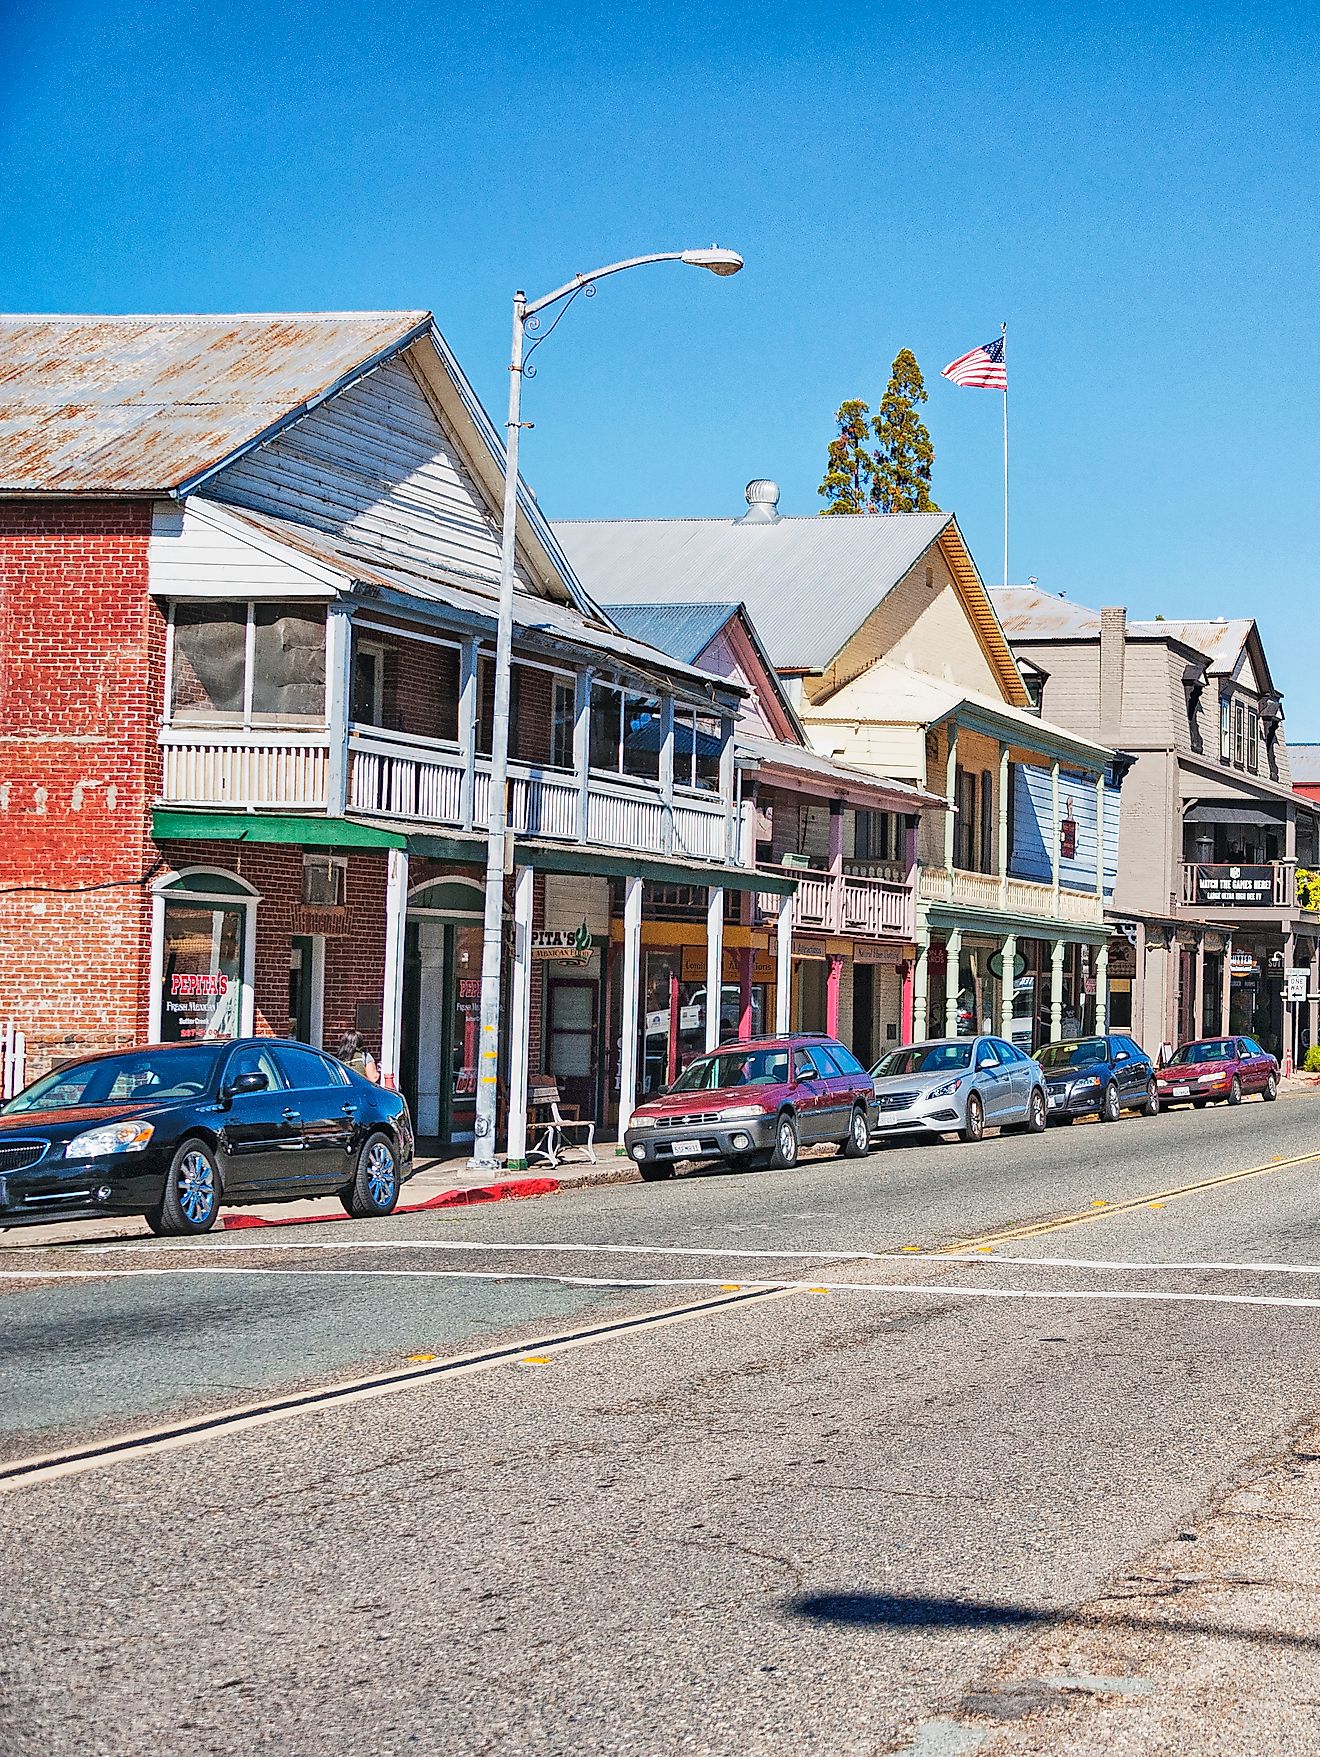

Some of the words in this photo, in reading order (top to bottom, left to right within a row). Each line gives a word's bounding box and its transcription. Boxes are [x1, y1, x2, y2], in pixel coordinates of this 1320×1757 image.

[1220, 880, 1231, 889] THE
[1232, 880, 1252, 889] GAMES
[531, 930, 576, 946] PITA'S
[171, 969, 228, 995] PEPITA'S
